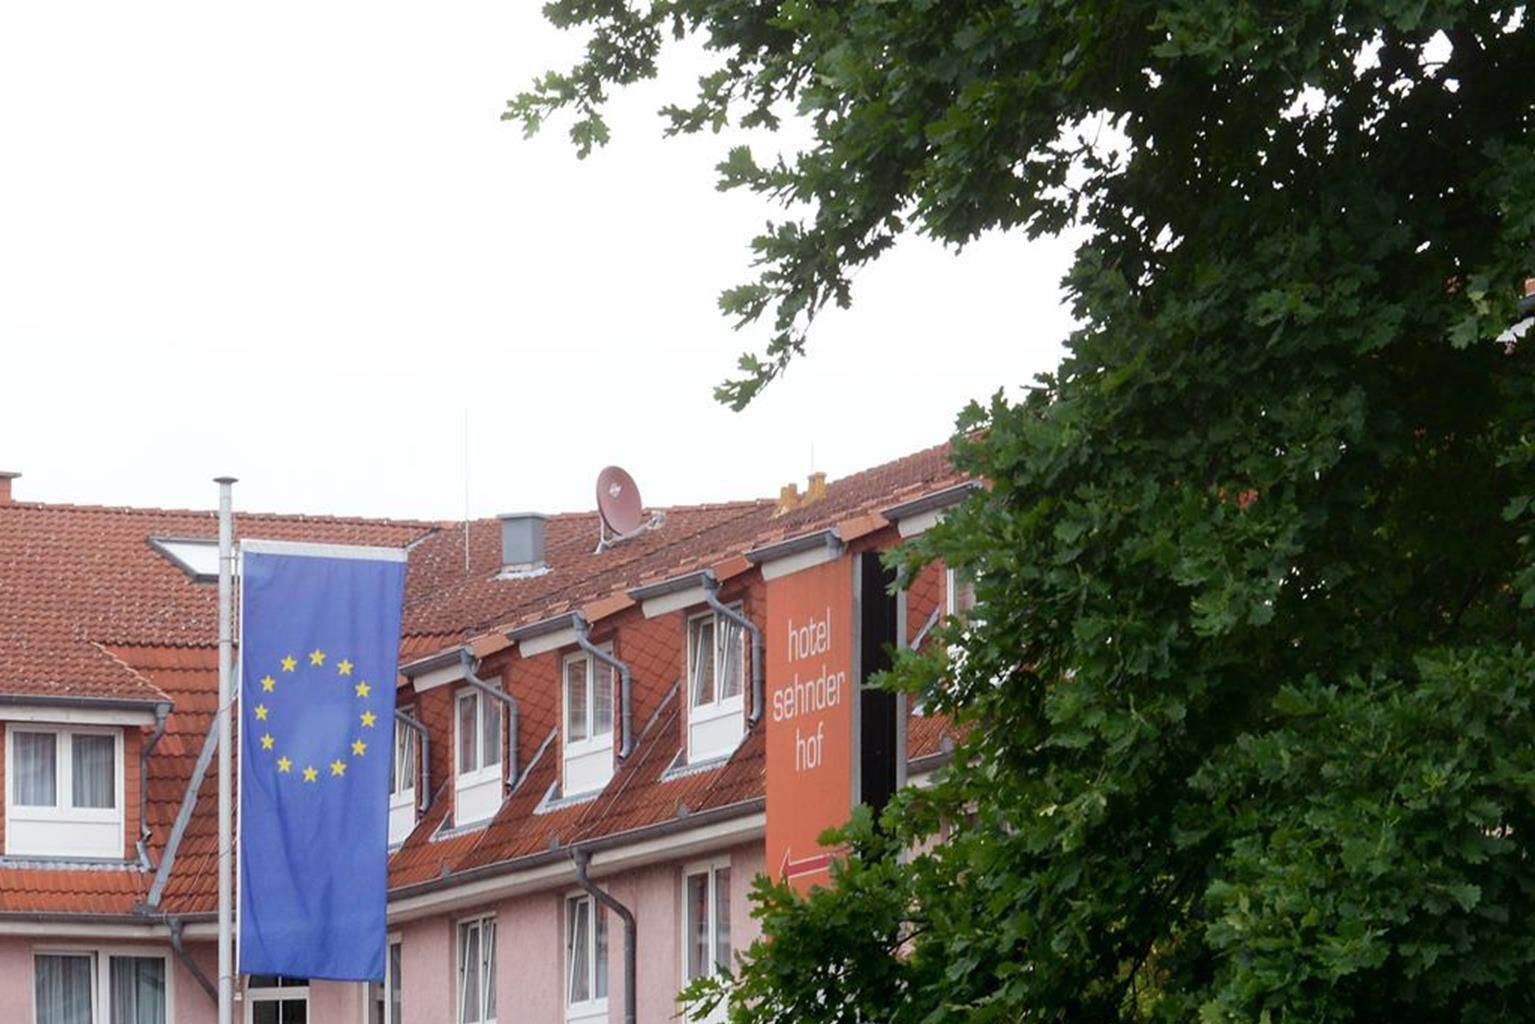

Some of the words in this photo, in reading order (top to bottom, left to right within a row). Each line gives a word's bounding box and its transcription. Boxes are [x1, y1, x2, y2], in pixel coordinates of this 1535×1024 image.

[787, 605, 831, 663] hotel
[772, 663, 846, 722] sehnder
[795, 720, 824, 773] hof
